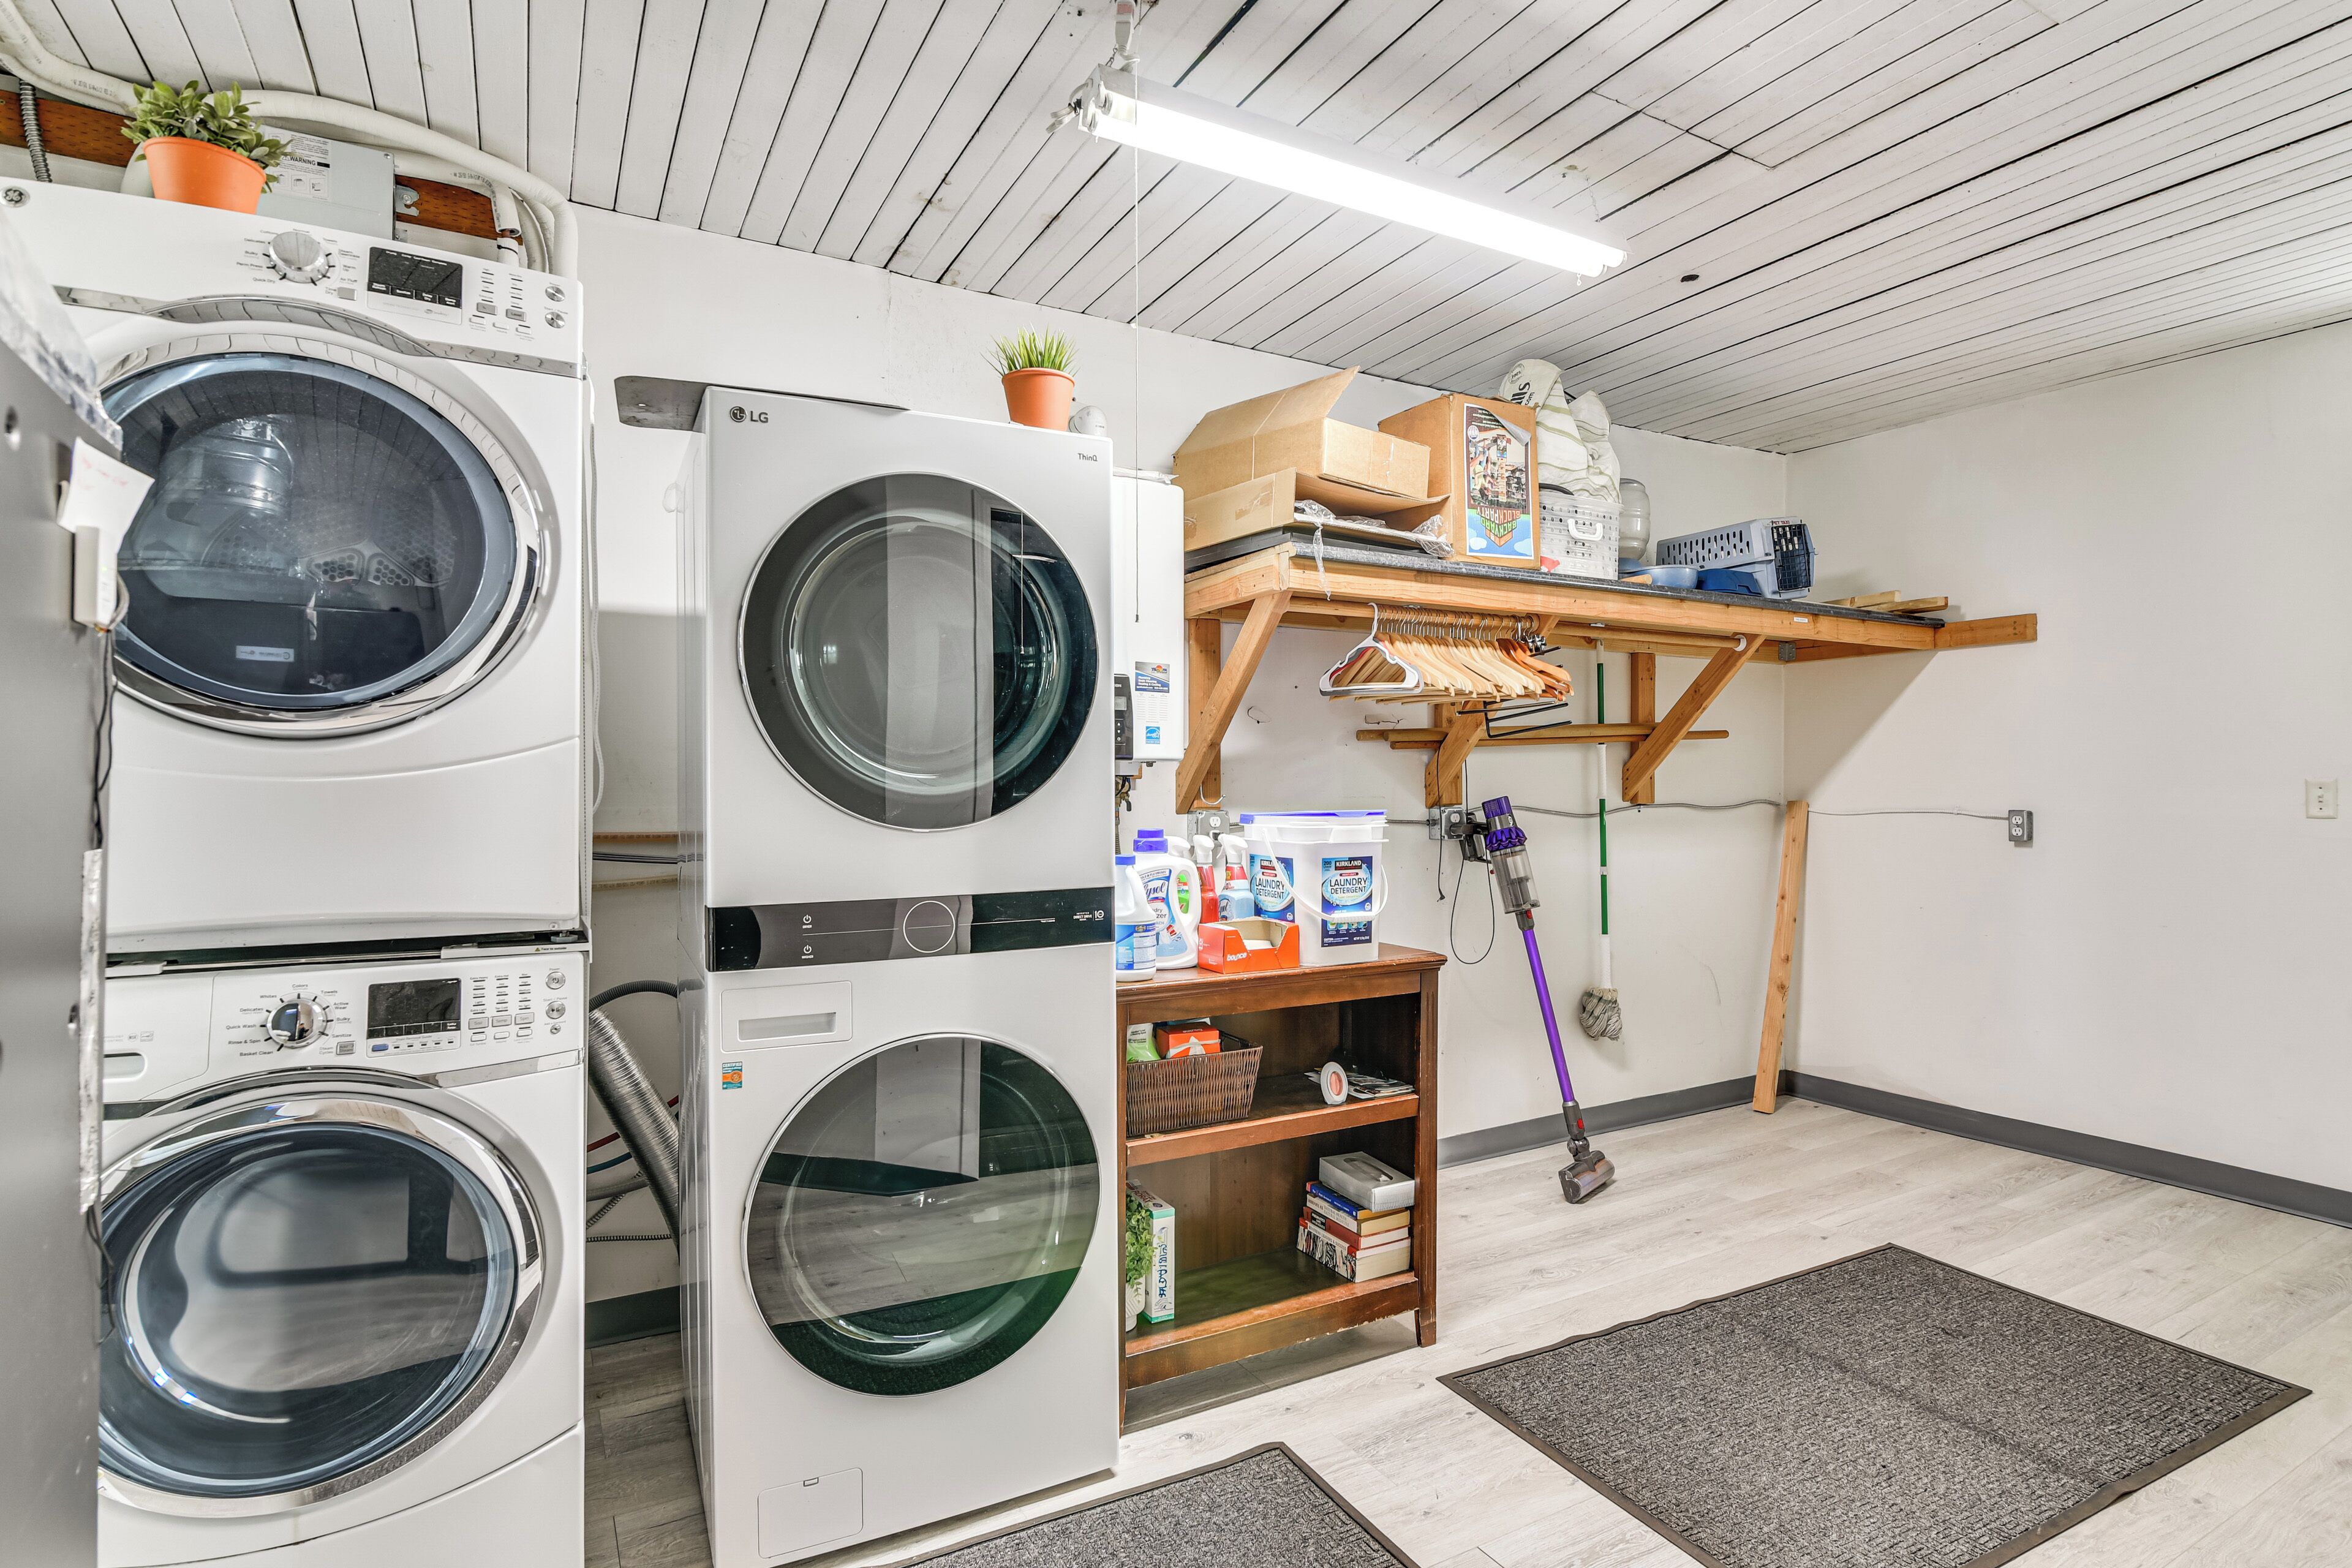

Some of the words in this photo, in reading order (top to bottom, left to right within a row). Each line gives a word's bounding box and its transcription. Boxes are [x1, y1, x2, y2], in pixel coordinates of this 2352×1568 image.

[290, 156, 316, 165] WARNING
[750, 410, 769, 423] LG
[1078, 453, 1098, 462] ThinQ
[1481, 517, 1517, 537] BACKYARD
[1255, 877, 1284, 890] LAUNDRY
[1330, 877, 1368, 887] LAUNDRY
[1256, 888, 1284, 899] DETERGENT
[1227, 952, 1247, 961] bounce
